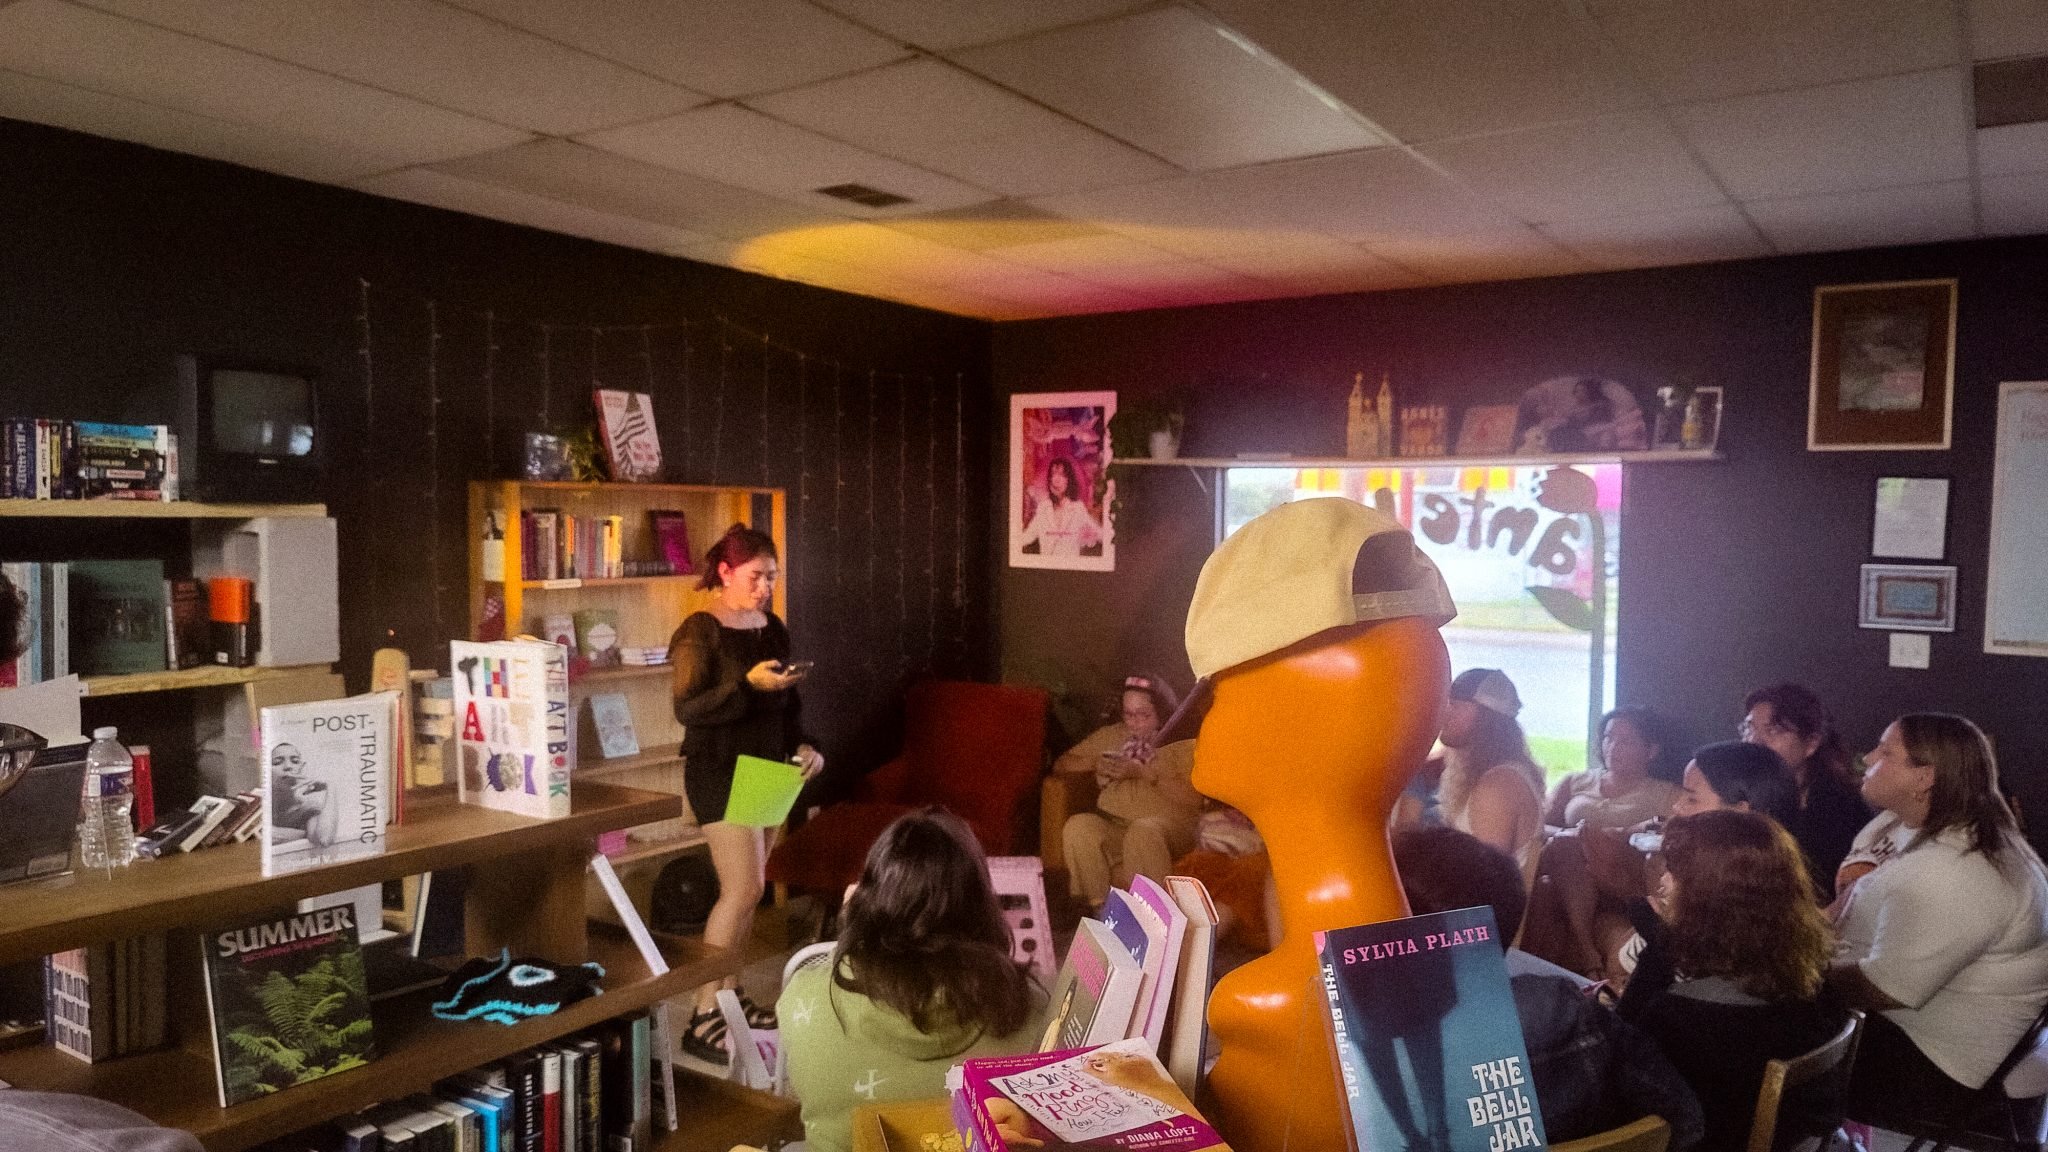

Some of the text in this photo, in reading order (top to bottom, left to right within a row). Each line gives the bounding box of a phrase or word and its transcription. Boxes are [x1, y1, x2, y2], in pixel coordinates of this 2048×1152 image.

[313, 714, 374, 733] POST-
[360, 731, 377, 844] TRAUMATIC
[218, 906, 354, 957] SUMMER
[1343, 926, 1490, 965] SYLVIA PLATH
[1322, 963, 1359, 1099] THE BELL JAR
[1002, 1077, 1036, 1095] Ask
[1471, 1056, 1525, 1093] THE
[1466, 1087, 1531, 1128] BELL
[1127, 1131, 1163, 1143] DIANA
[1489, 1115, 1541, 1152] JAR
